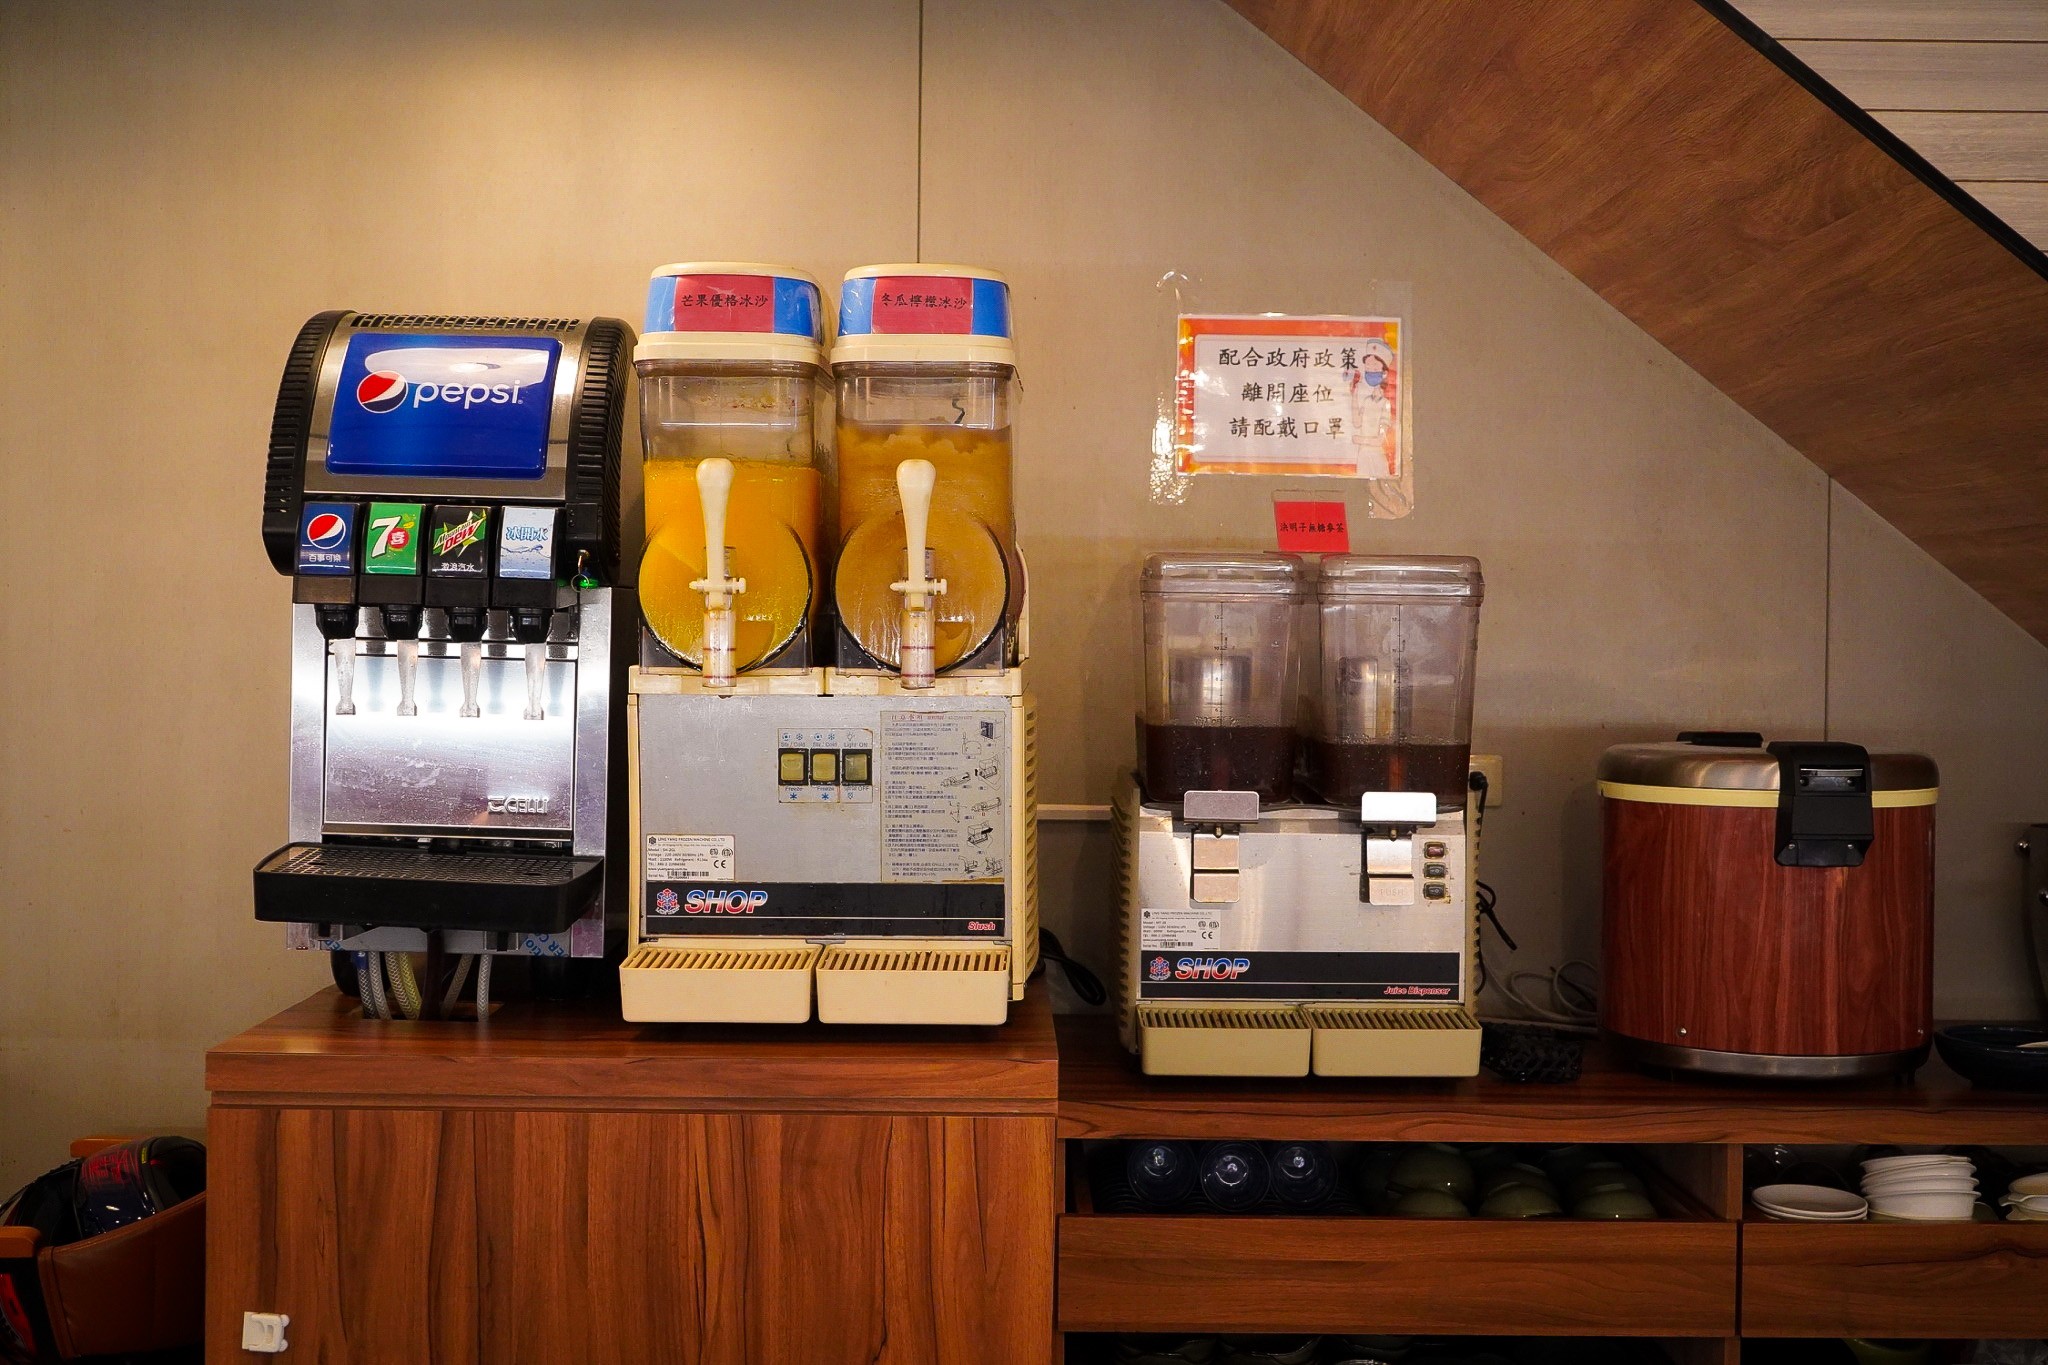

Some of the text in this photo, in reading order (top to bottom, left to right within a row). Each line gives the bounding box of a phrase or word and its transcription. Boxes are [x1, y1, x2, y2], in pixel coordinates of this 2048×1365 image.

[680, 293, 769, 308] 芒果優格冰沙
[880, 293, 968, 310] 冬瓜檸檬冰沙
[1218, 346, 1360, 370] 配合政府政策
[412, 379, 521, 409] pepsi
[1240, 382, 1334, 404] 離開座位
[1228, 416, 1346, 440] 請配戴口罩
[684, 889, 769, 914] SHOP
[968, 921, 996, 931] Slush
[1174, 957, 1251, 980] SHOP
[1383, 985, 1452, 997] Juice Dispenser
